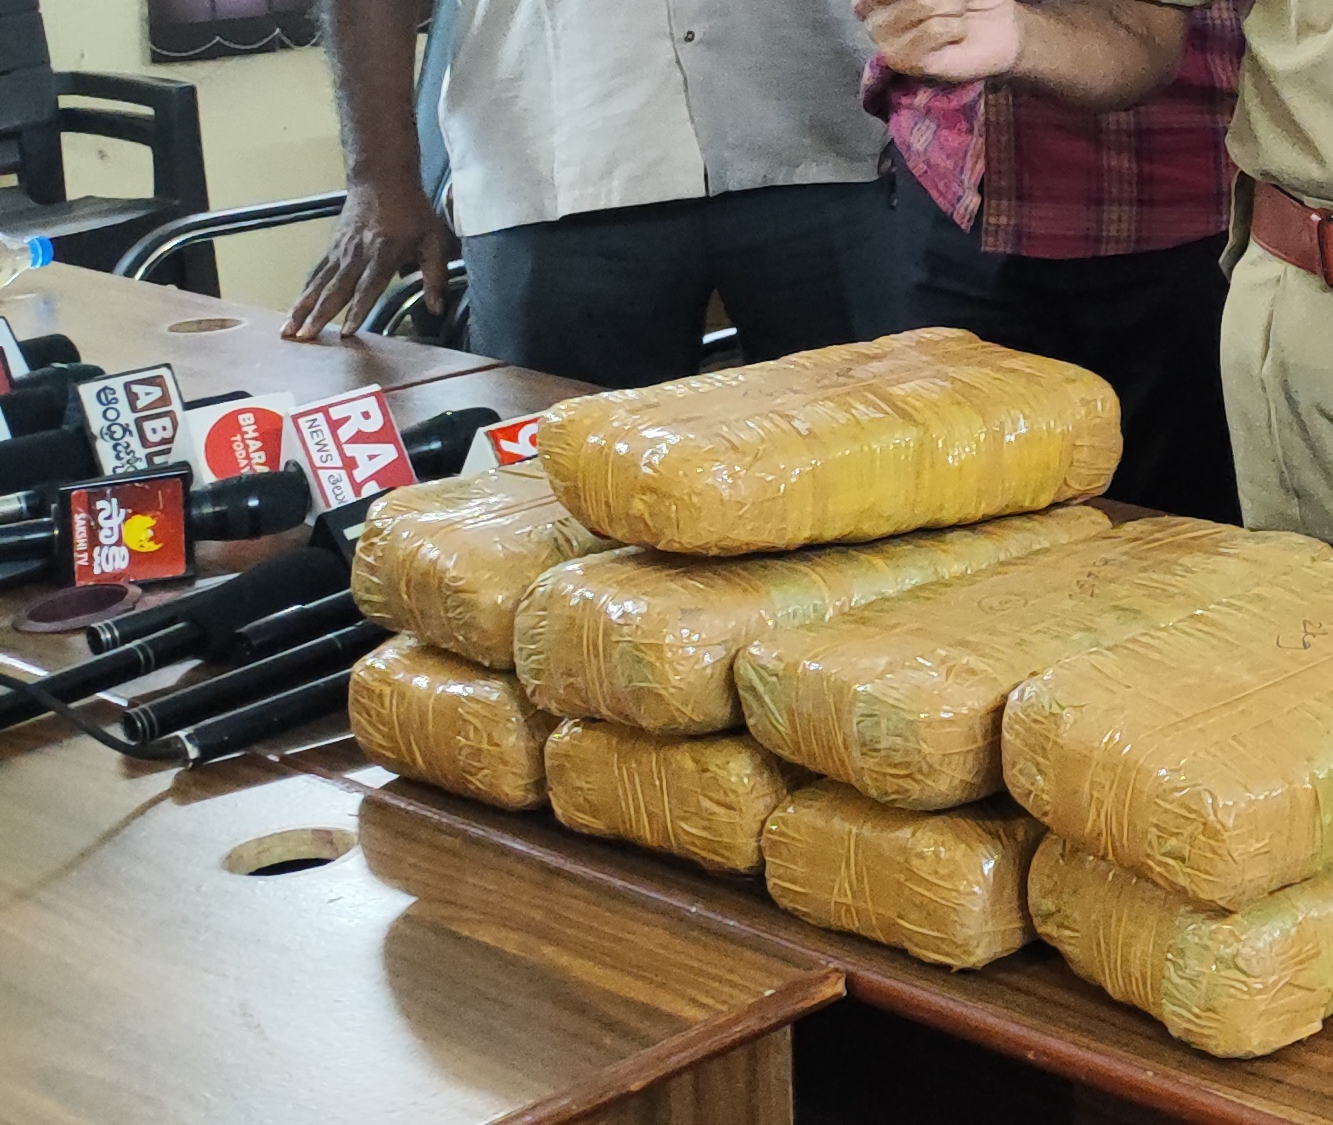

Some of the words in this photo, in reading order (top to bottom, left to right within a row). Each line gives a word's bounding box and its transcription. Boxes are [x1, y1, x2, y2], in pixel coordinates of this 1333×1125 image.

[305, 417, 333, 464] NEWS
[74, 511, 88, 551] SAKSHI
[75, 552, 89, 566] TV
